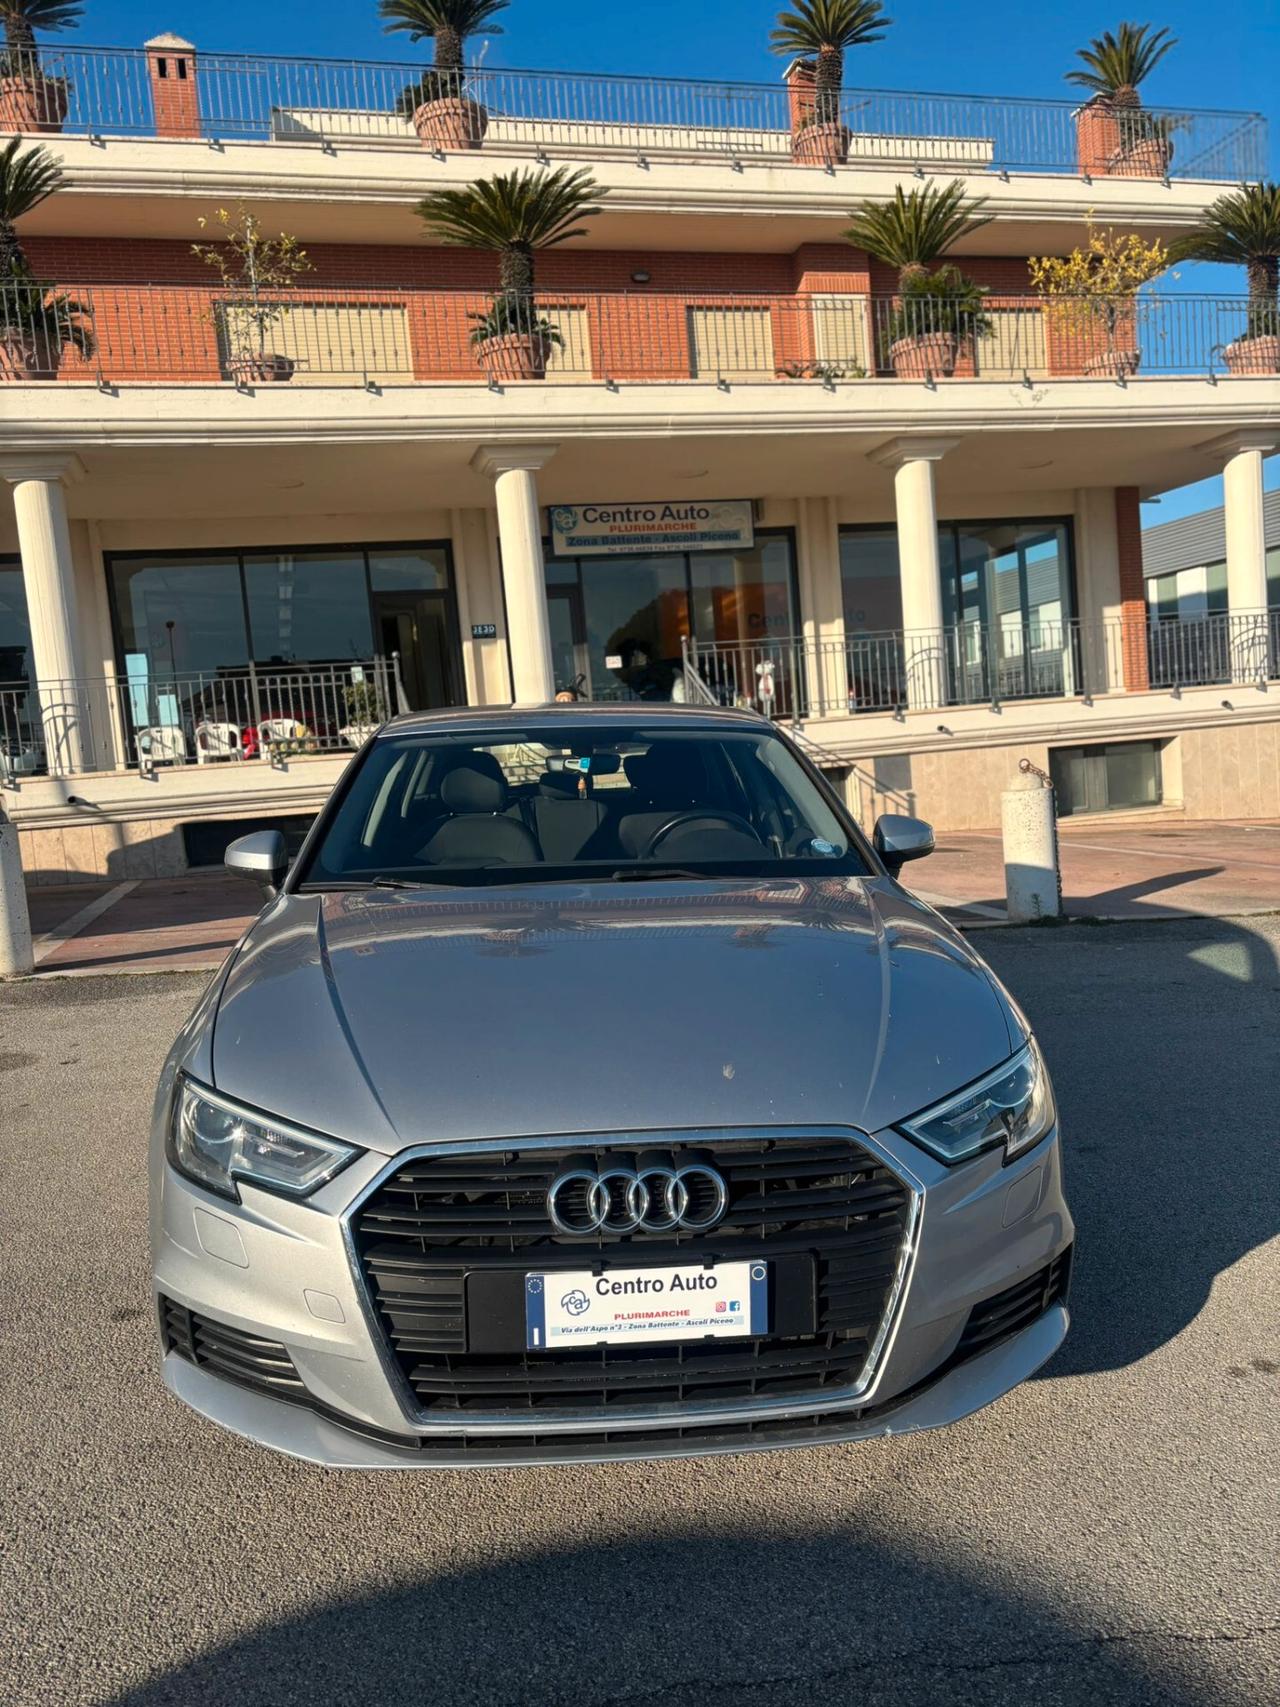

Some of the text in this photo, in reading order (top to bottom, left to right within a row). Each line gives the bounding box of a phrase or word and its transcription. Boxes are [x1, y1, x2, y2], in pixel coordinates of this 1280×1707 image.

[582, 505, 709, 523] Centro Auto
[608, 522, 697, 533] PLURIMARCHE
[567, 536, 598, 547] Zona
[601, 534, 652, 545] Battente
[662, 533, 697, 543] Ascoli
[700, 531, 738, 541] Piceno
[596, 1273, 718, 1296] Centro Auto
[614, 1309, 690, 1320] PLURIMARCHE
[561, 1326, 573, 1334] Via
[574, 1324, 608, 1333] dell'Aspo
[648, 1320, 680, 1329] Battente
[686, 1318, 708, 1326] Ascoli
[709, 1317, 734, 1325] Piceno
